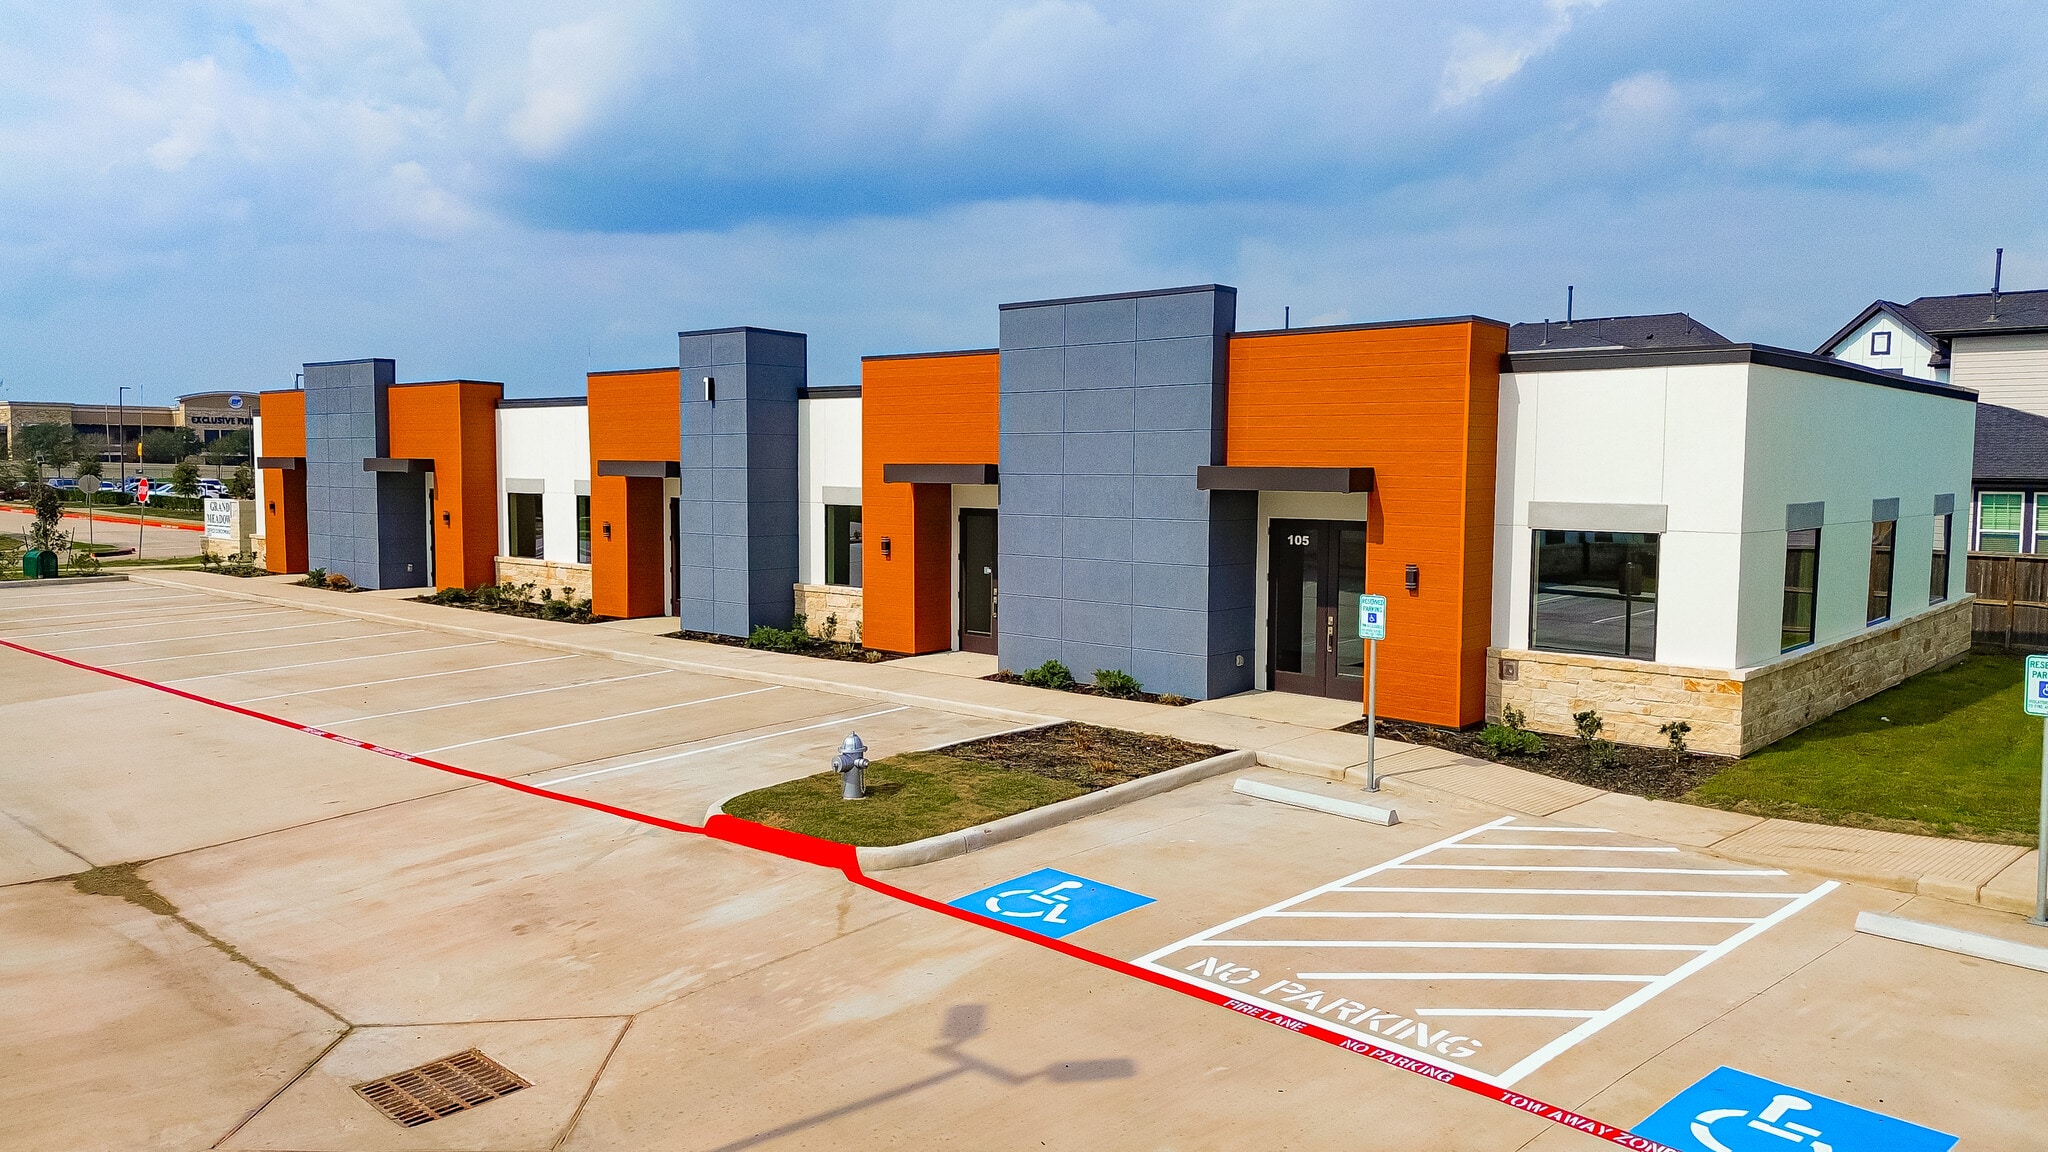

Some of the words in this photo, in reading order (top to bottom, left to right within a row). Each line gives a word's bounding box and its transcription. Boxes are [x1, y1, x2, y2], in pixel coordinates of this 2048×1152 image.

[191, 416, 235, 425] EXCLUSIVE
[210, 501, 230, 512] GRAND
[1287, 534, 1310, 546] 105
[1185, 957, 1260, 984] NO
[1258, 979, 1483, 1058] PARKING
[1223, 999, 1264, 1016] FIRE
[1259, 1012, 1307, 1032] LANE
[1339, 1038, 1369, 1053] NO
[1369, 1049, 1455, 1083] PARKING
[1501, 1091, 1548, 1113] TOW
[1546, 1110, 1613, 1136] AWAY
